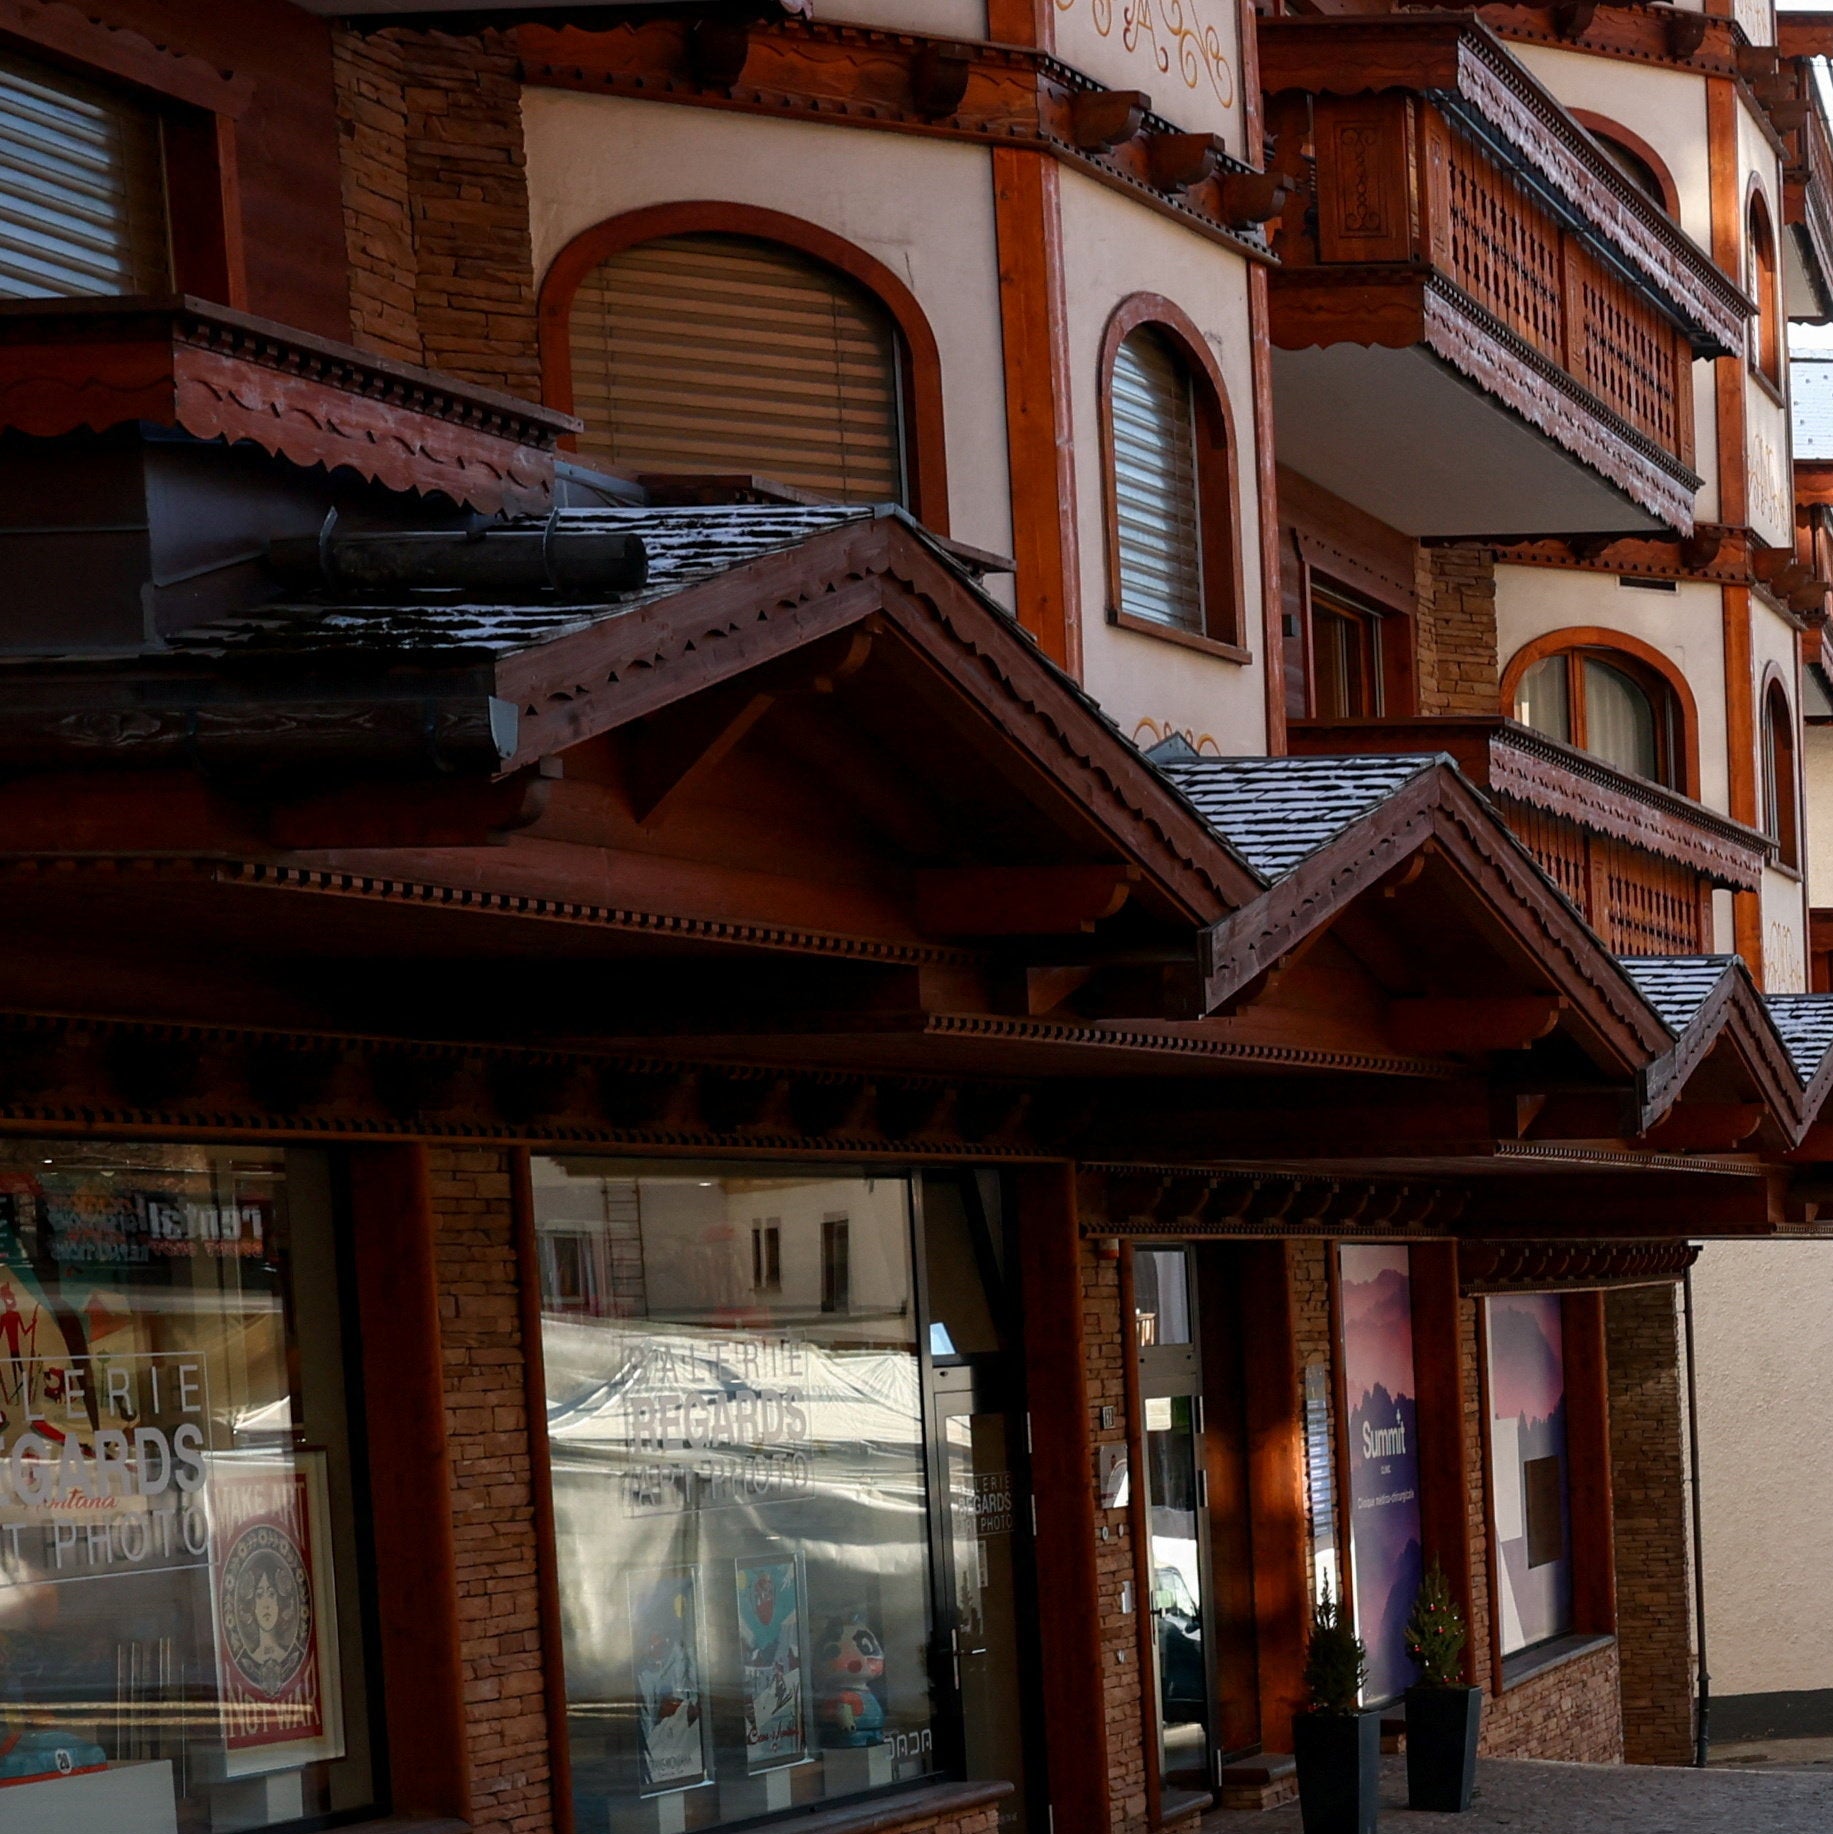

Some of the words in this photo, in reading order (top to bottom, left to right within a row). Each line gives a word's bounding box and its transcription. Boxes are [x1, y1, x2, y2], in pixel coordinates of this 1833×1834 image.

[631, 1386, 807, 1450] REGARDS
[1362, 1409, 1407, 1459] Summit
[0, 1423, 207, 1507] GARDS
[710, 1451, 808, 1499] PHOTO
[214, 1484, 266, 1540] MAKE
[958, 1491, 1012, 1515] REGARDS
[979, 1513, 1014, 1532] PHOTO
[54, 1506, 209, 1569] PHOTO
